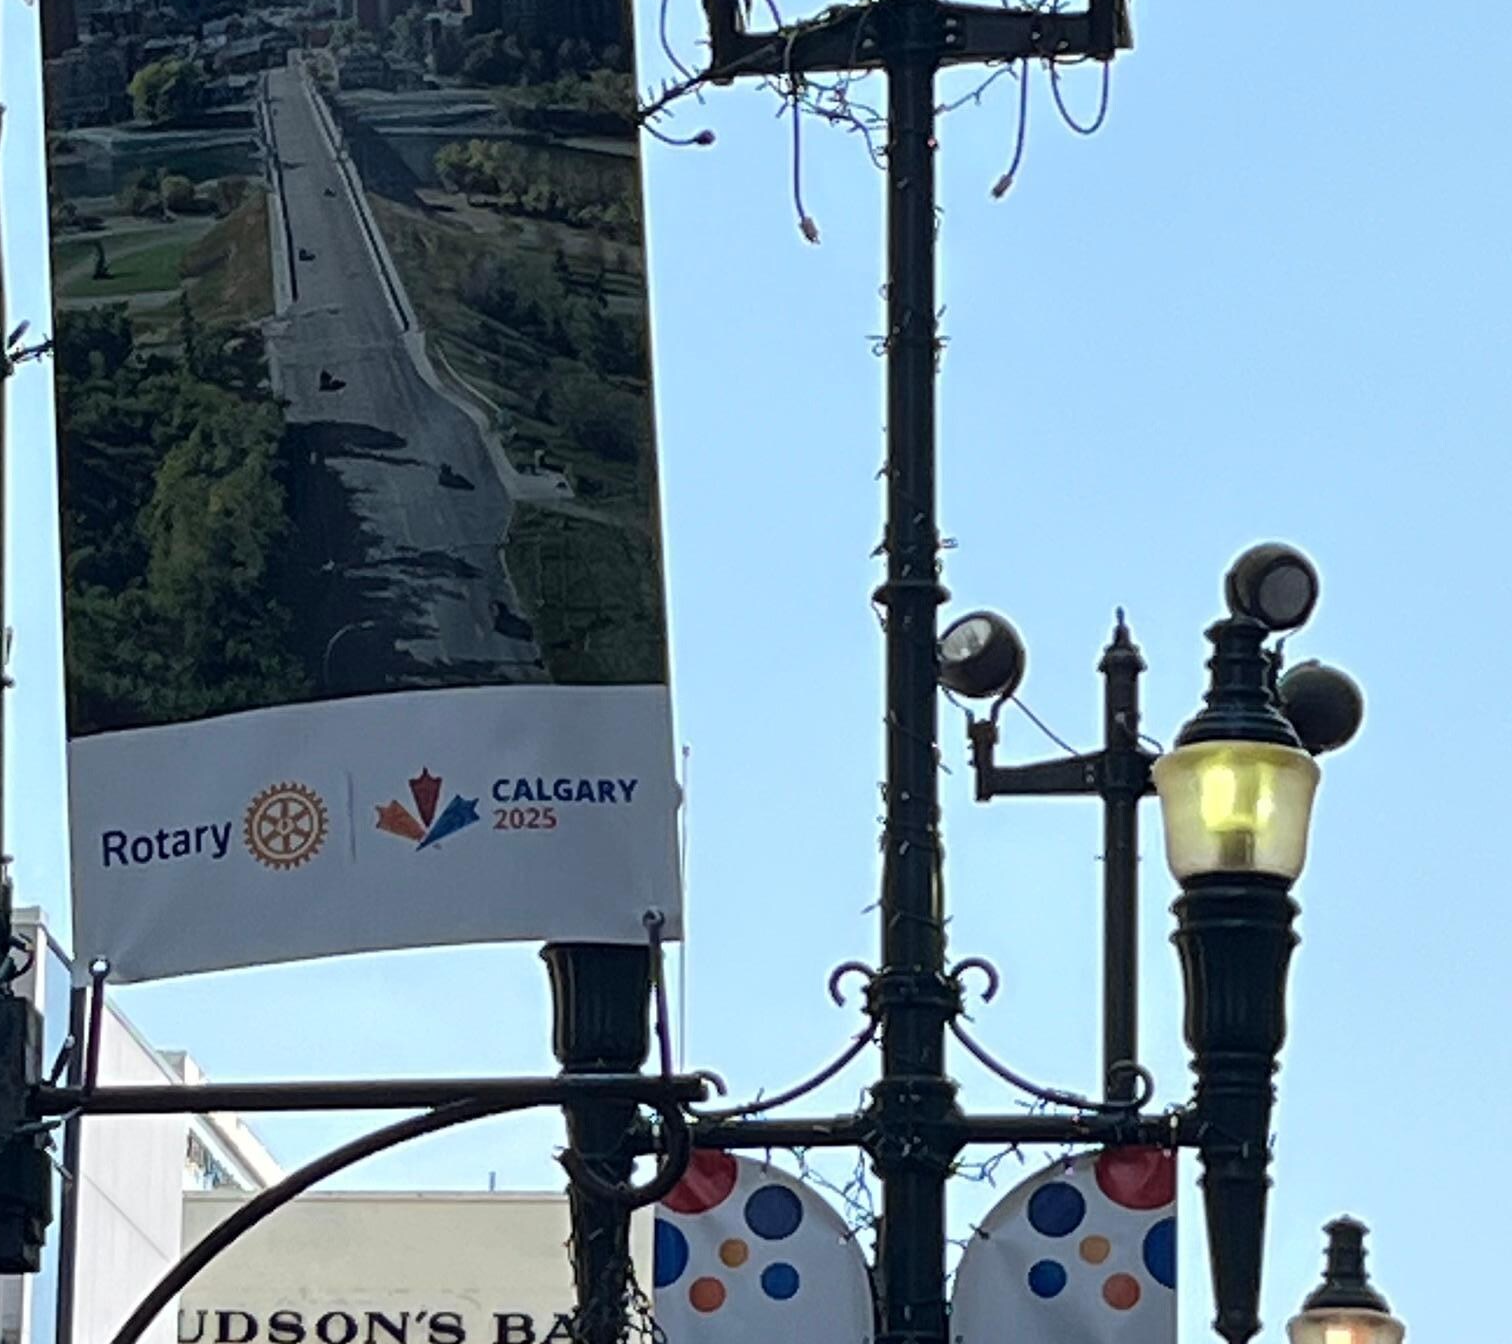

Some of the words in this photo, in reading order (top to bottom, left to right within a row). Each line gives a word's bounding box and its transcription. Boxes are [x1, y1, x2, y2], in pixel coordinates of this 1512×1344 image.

[491, 777, 638, 803] CALGARY
[492, 807, 558, 830] 2025
[101, 821, 233, 868] Rotary
